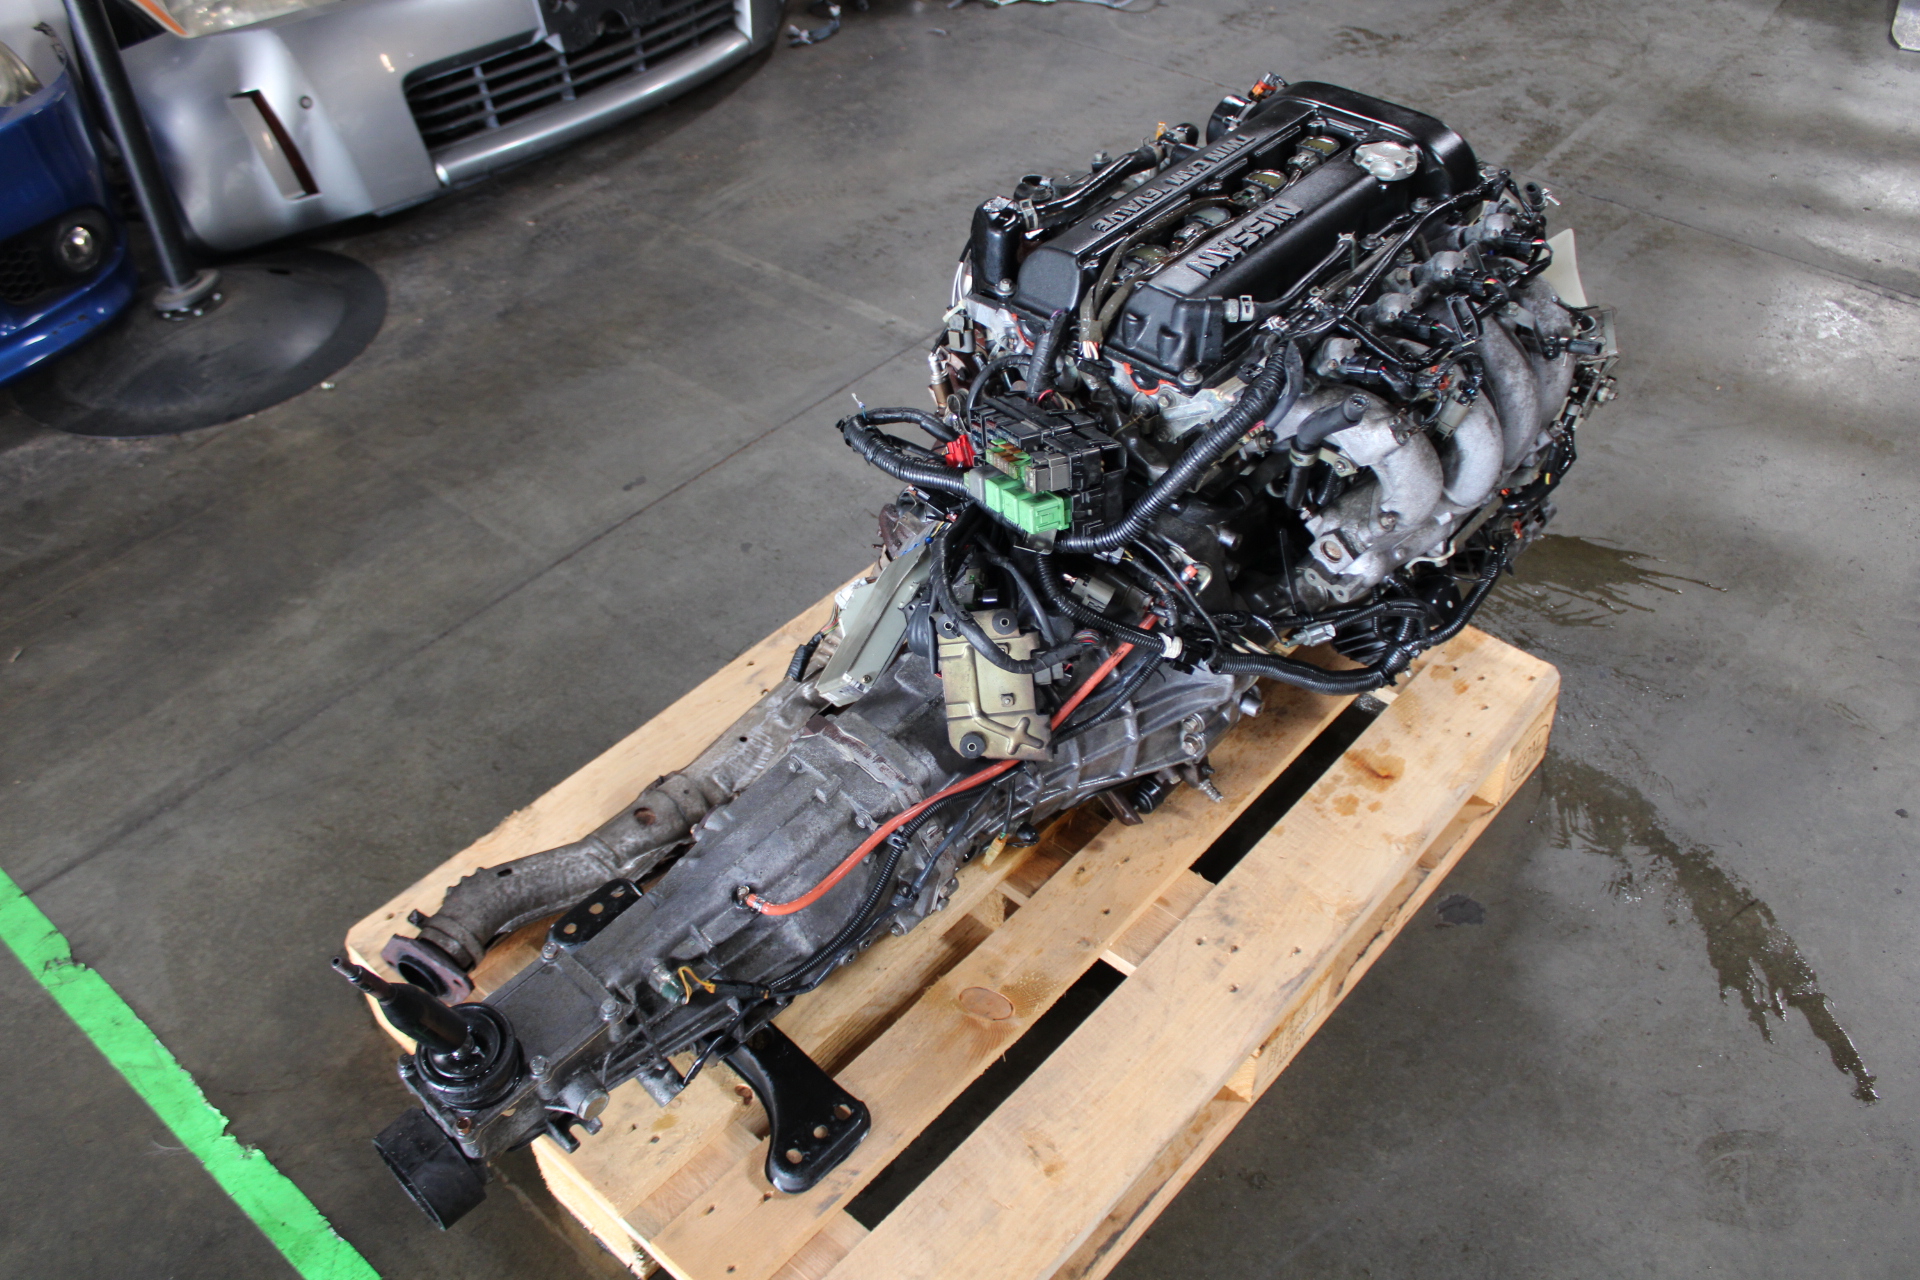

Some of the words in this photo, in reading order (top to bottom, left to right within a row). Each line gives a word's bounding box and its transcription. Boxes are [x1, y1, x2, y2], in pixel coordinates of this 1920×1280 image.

[1205, 134, 1256, 163] TWIN
[1165, 158, 1212, 187] CAM
[1186, 202, 1304, 280] NISSAN
